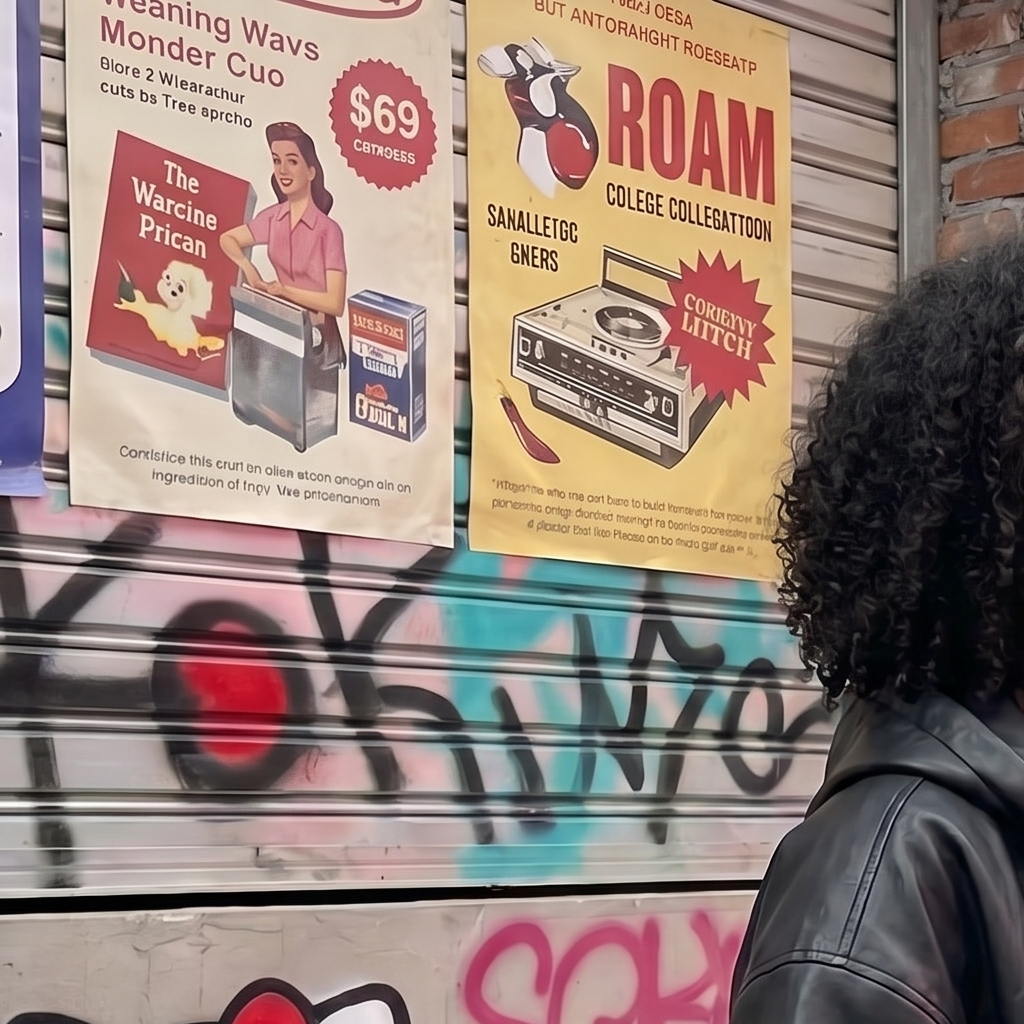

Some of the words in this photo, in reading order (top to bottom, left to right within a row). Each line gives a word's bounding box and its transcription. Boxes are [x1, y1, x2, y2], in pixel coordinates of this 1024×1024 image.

[100, 15, 216, 70] Monder
[226, 51, 285, 88] Cuo
[145, 67, 154, 82] 2
[161, 93, 197, 115] Tree
[349, 83, 420, 140] $69
[607, 63, 776, 206] ROAM
[163, 159, 200, 194] The
[606, 182, 664, 217] COLEGE
[131, 176, 217, 231] Warcine
[138, 212, 207, 259] Prican
